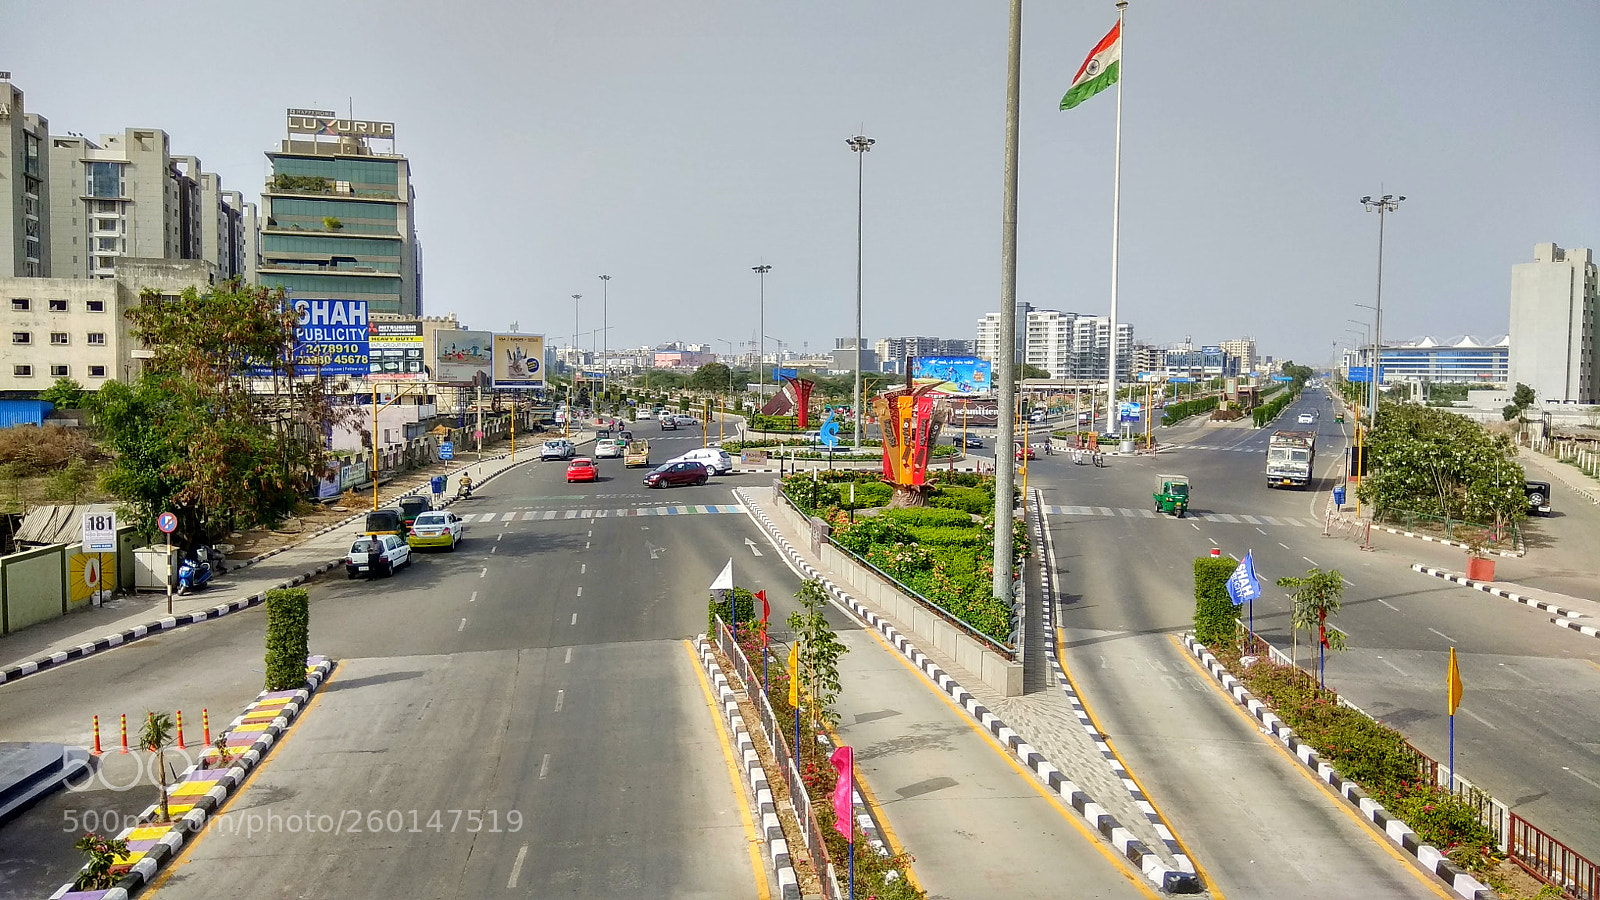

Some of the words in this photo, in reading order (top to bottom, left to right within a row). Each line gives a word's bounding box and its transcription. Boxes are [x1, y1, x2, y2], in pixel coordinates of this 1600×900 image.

[288, 117, 394, 135] LUXURIA
[294, 300, 367, 326] SHAH
[296, 328, 368, 341] PUBLICITY
[305, 344, 359, 355] 2478910
[334, 355, 369, 365] 45678
[88, 515, 113, 531] 181
[1235, 563, 1255, 599] SHAH
